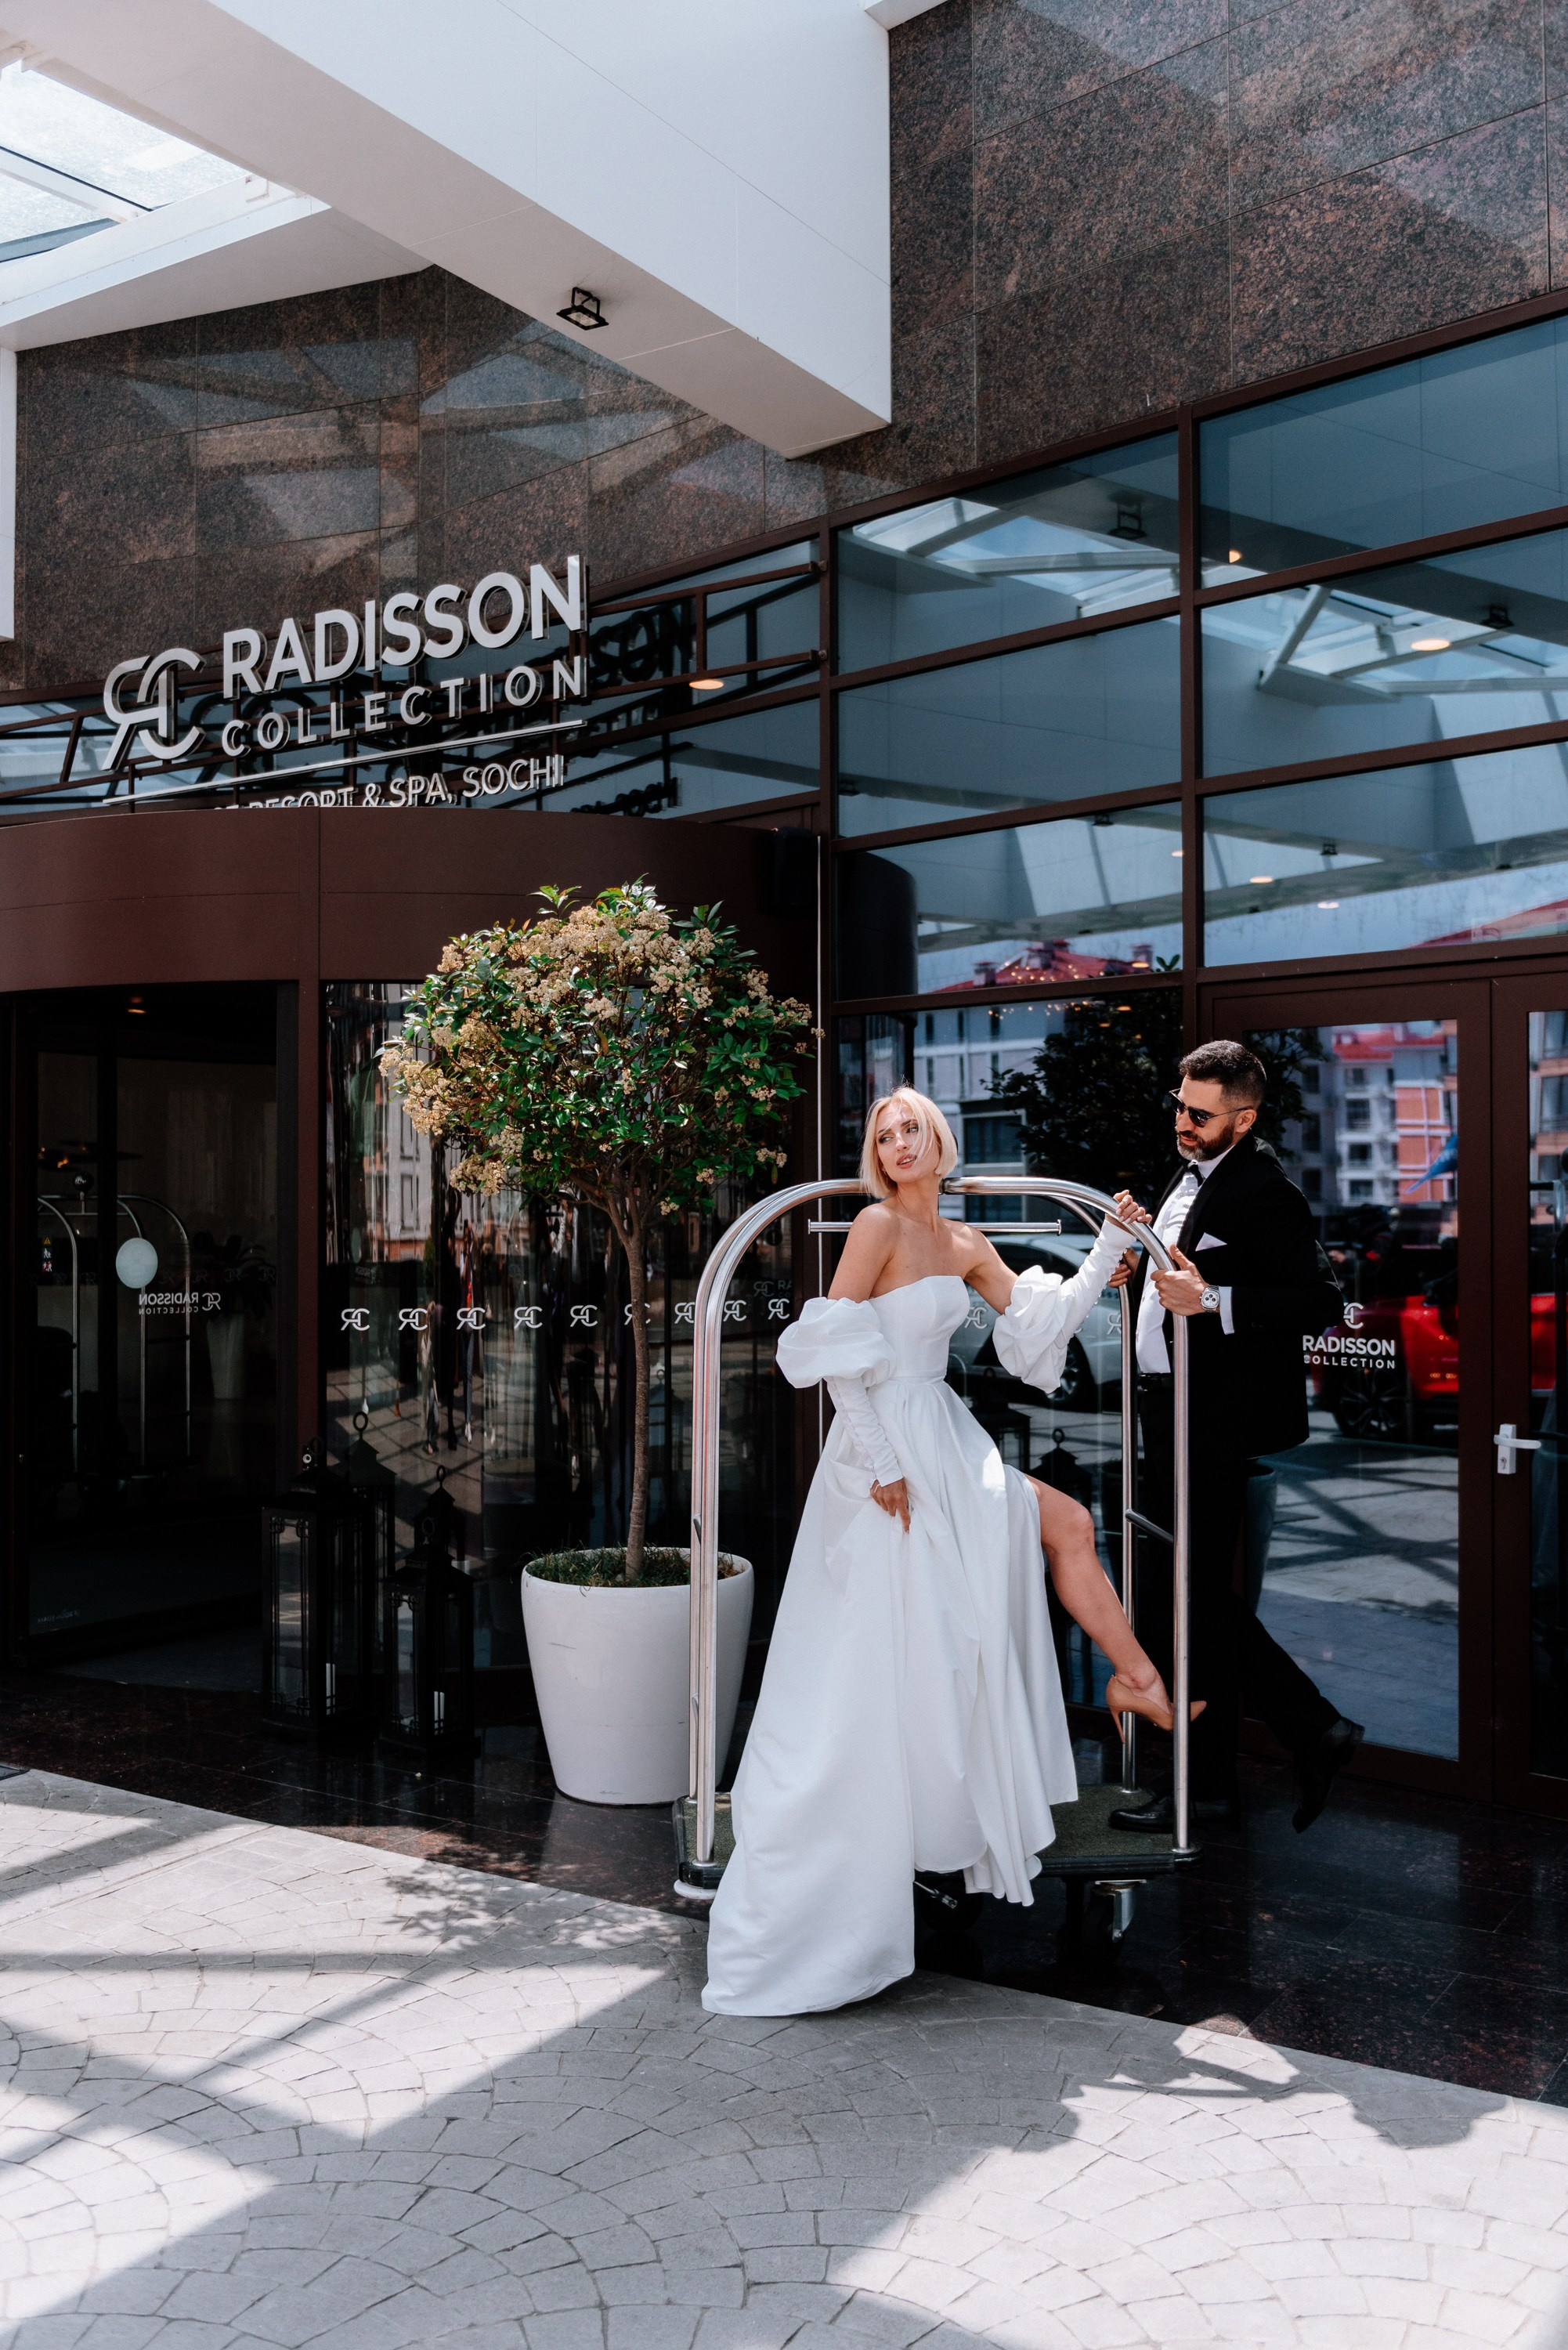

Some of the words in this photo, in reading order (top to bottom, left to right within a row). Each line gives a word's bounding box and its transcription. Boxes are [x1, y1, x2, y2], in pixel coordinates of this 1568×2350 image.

[223, 555, 584, 700] RADISSON
[222, 655, 584, 757] COLLECTION
[363, 783, 385, 808] &
[389, 772, 455, 807] SPA,
[462, 754, 564, 797] SOCHI
[1302, 1335, 1395, 1356] RADISSON
[1303, 1354, 1395, 1369] COLLECTION
